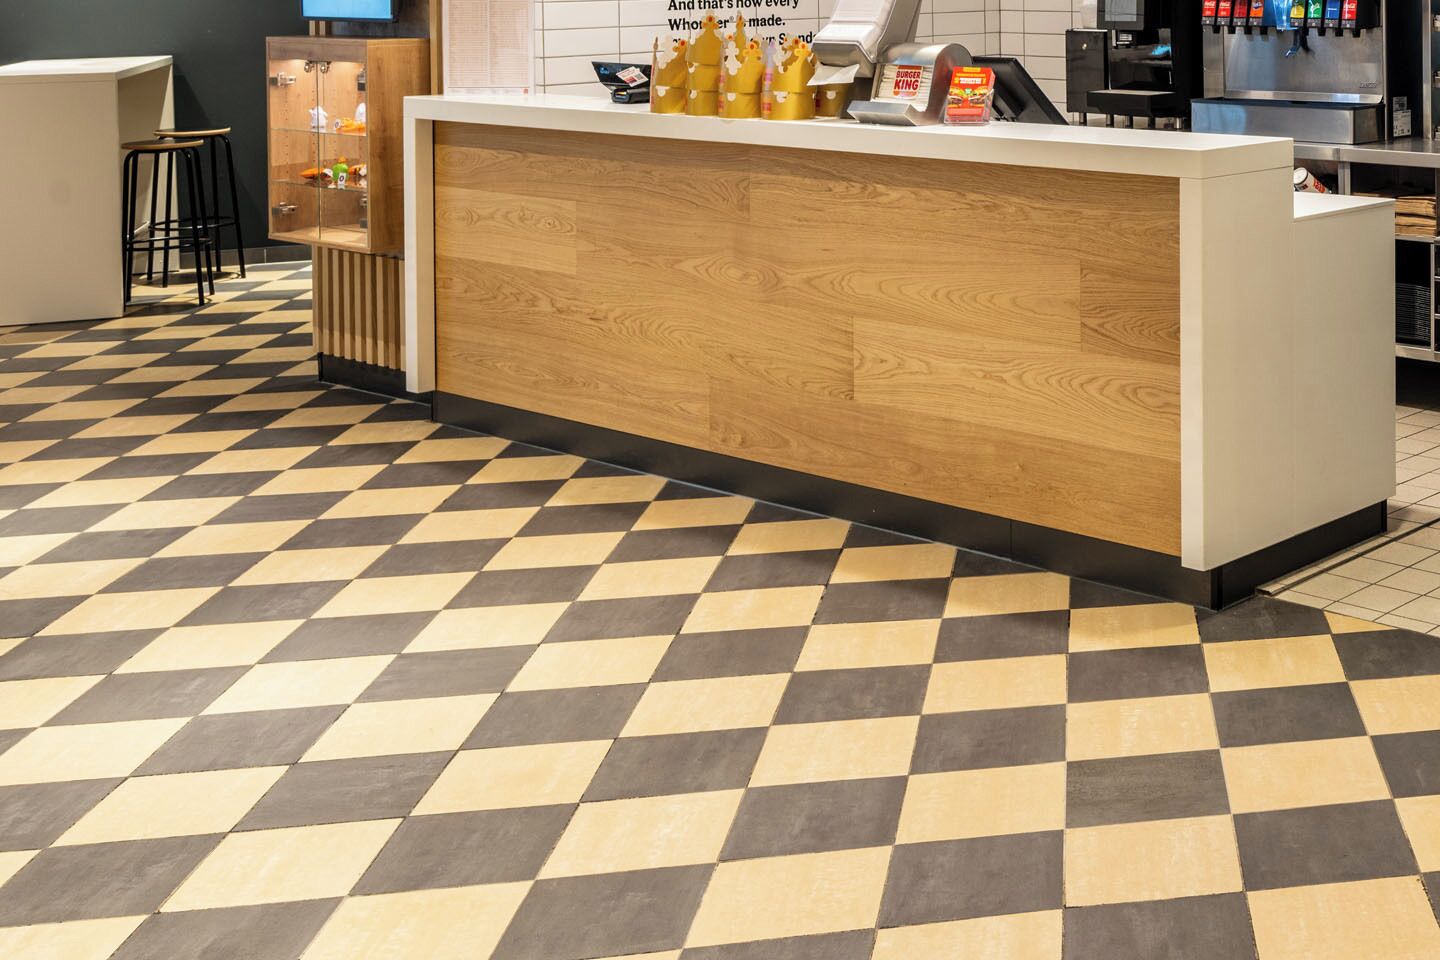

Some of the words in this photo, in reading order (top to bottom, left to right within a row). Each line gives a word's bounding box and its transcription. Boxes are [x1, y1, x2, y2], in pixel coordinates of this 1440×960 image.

[748, 15, 786, 27] made.
[896, 70, 921, 78] BURGER
[894, 79, 918, 90] KING
